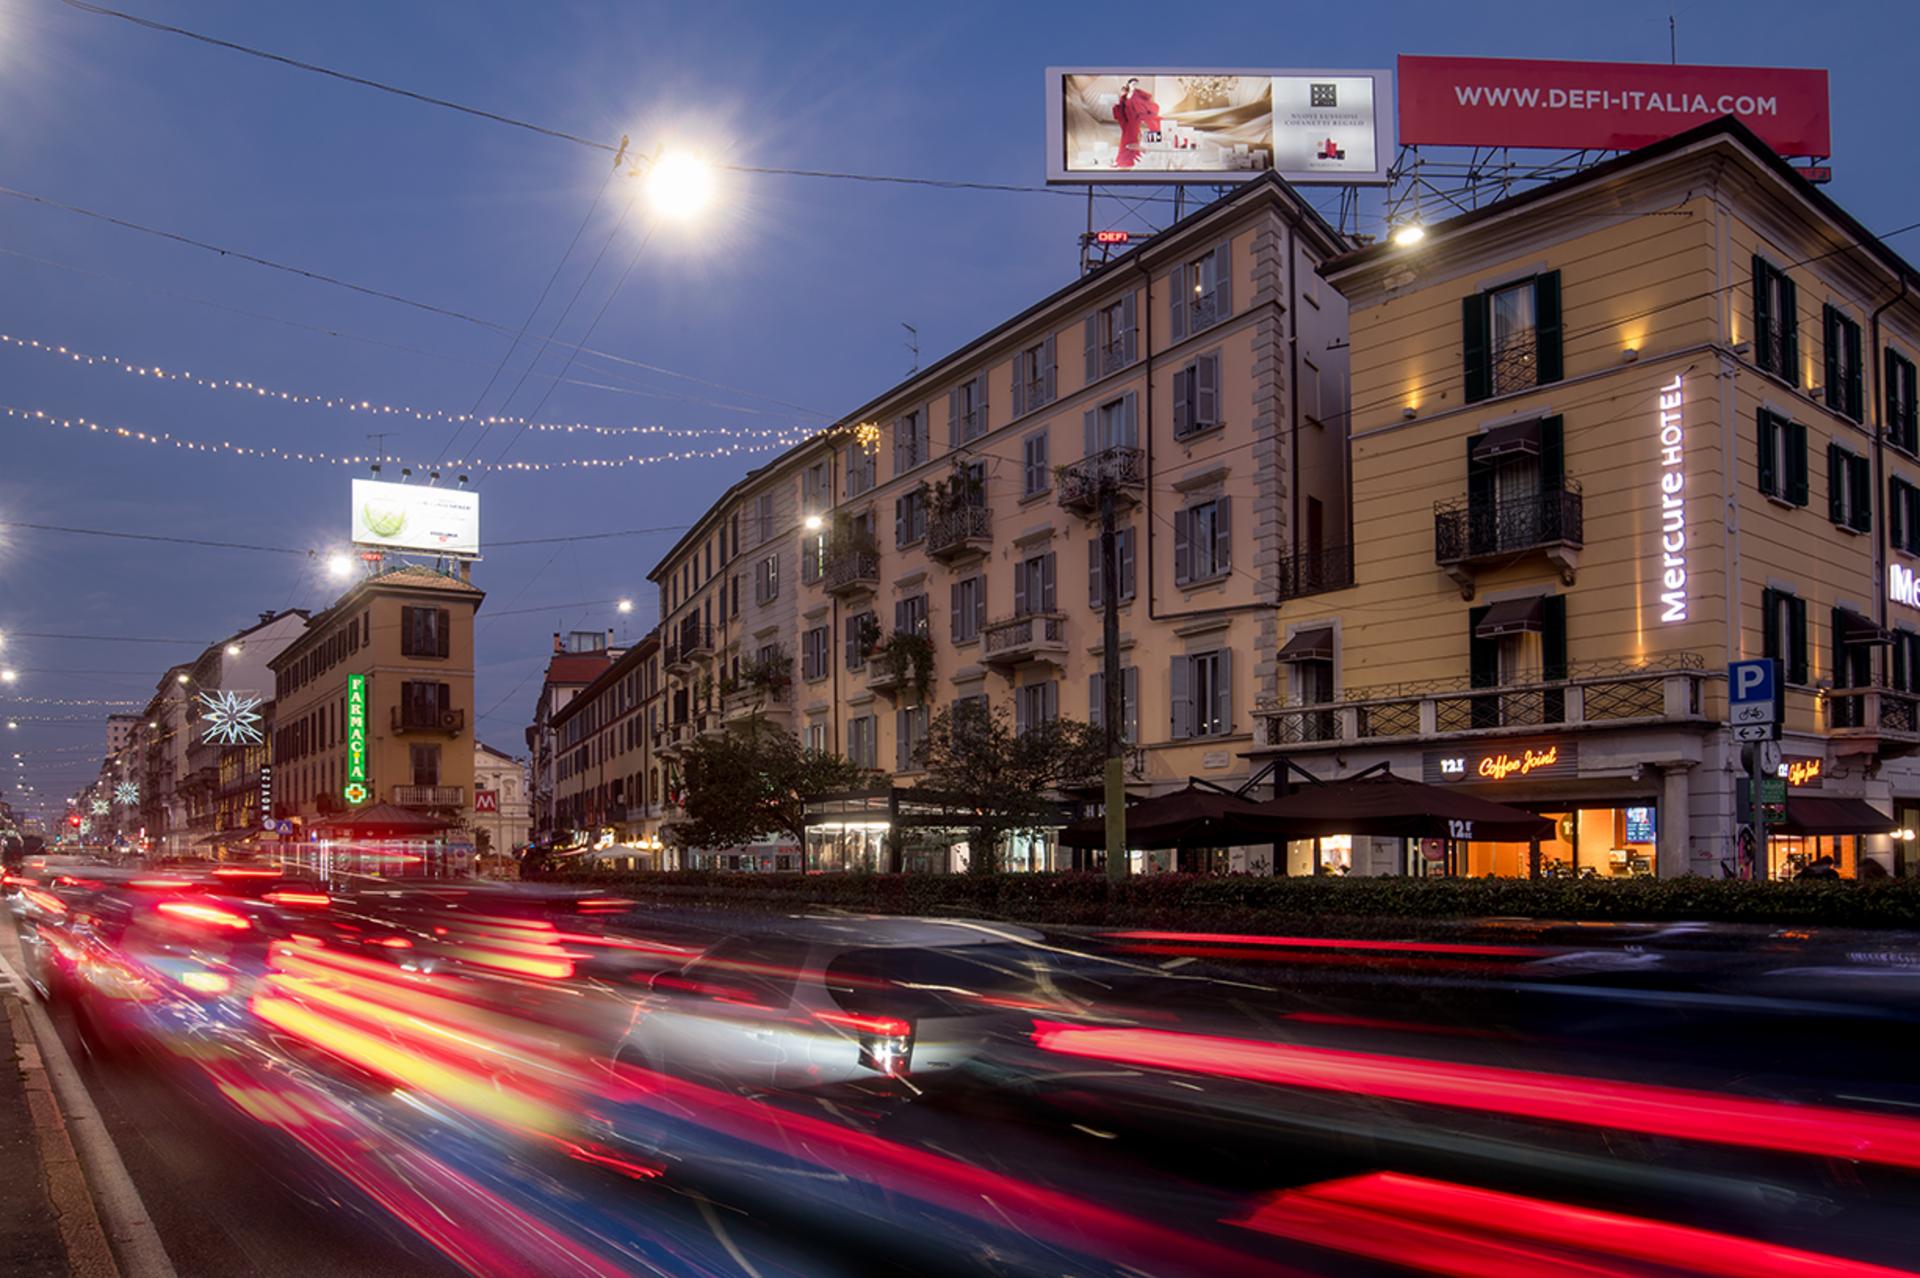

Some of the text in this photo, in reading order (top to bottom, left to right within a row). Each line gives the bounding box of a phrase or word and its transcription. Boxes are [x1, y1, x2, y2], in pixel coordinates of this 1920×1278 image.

[1454, 86, 1777, 116] WWW.DEFI-ITALIA.COM
[1098, 232, 1128, 242] DEFI
[1660, 374, 1683, 466] HOTEL
[1737, 665, 1764, 699] P
[350, 679, 363, 778] FARMACIA
[1479, 754, 1520, 779] Coffee
[1521, 746, 1557, 774] Joint
[476, 795, 495, 809] M
